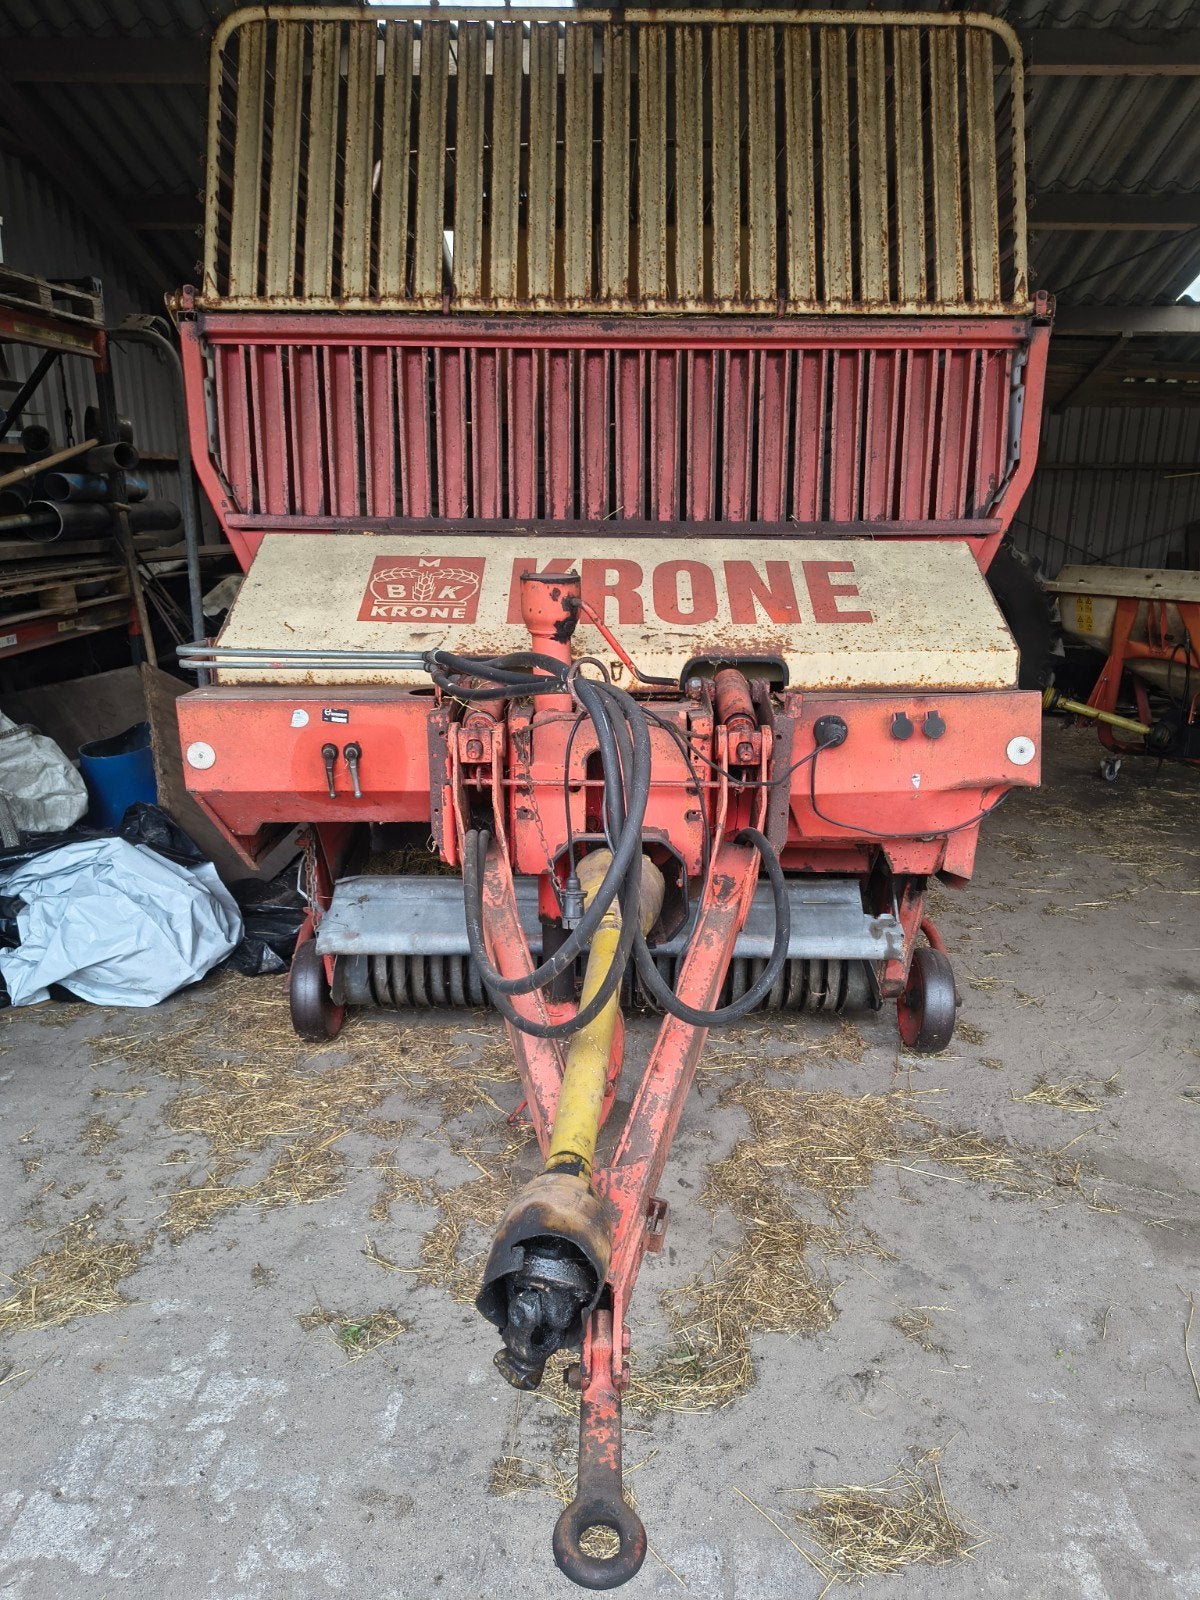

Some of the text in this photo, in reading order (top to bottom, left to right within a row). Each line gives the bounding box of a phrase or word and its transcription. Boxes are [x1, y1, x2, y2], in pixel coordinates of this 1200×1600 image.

[418, 558, 441, 568] M
[386, 584, 464, 599] B K
[370, 605, 466, 619] KRONE
